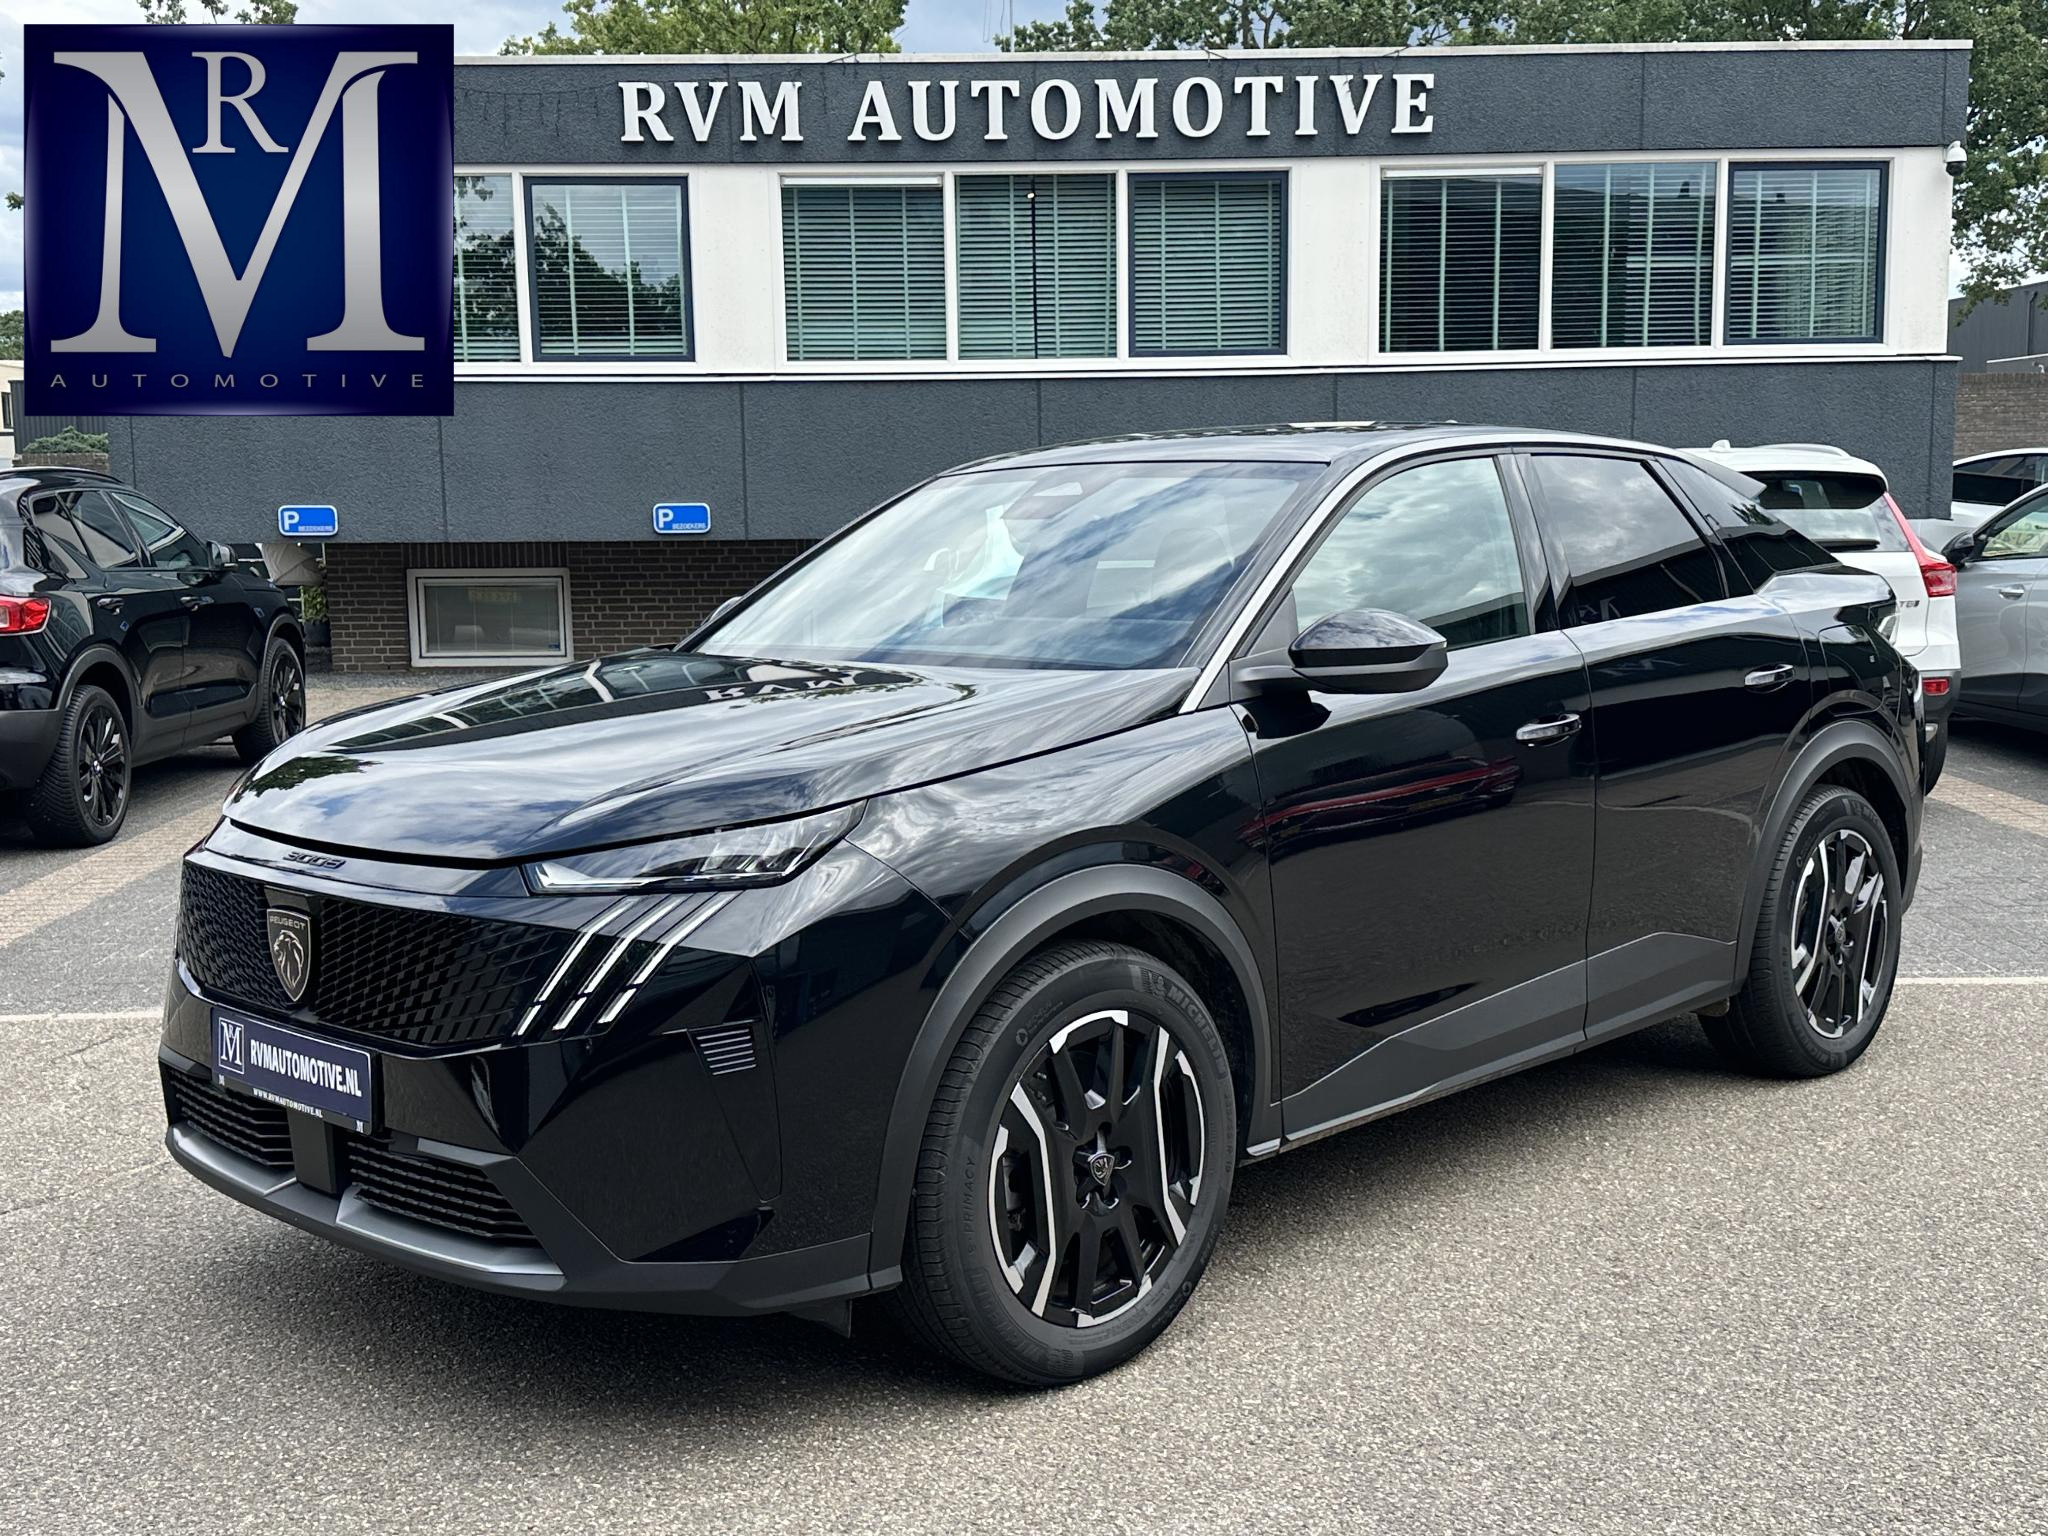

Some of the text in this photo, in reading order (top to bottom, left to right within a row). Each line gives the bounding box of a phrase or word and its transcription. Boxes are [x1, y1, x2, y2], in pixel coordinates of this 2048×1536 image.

[618, 73, 1435, 142] RVM AUTOMOTIVE
[283, 511, 299, 531] P
[657, 509, 673, 529] P
[283, 851, 346, 869] 3008
[269, 915, 306, 931] PEUGEOT
[1167, 983, 1229, 1080] MICHELIN
[250, 1039, 362, 1097] RVMAUTOMOTIVE.NL
